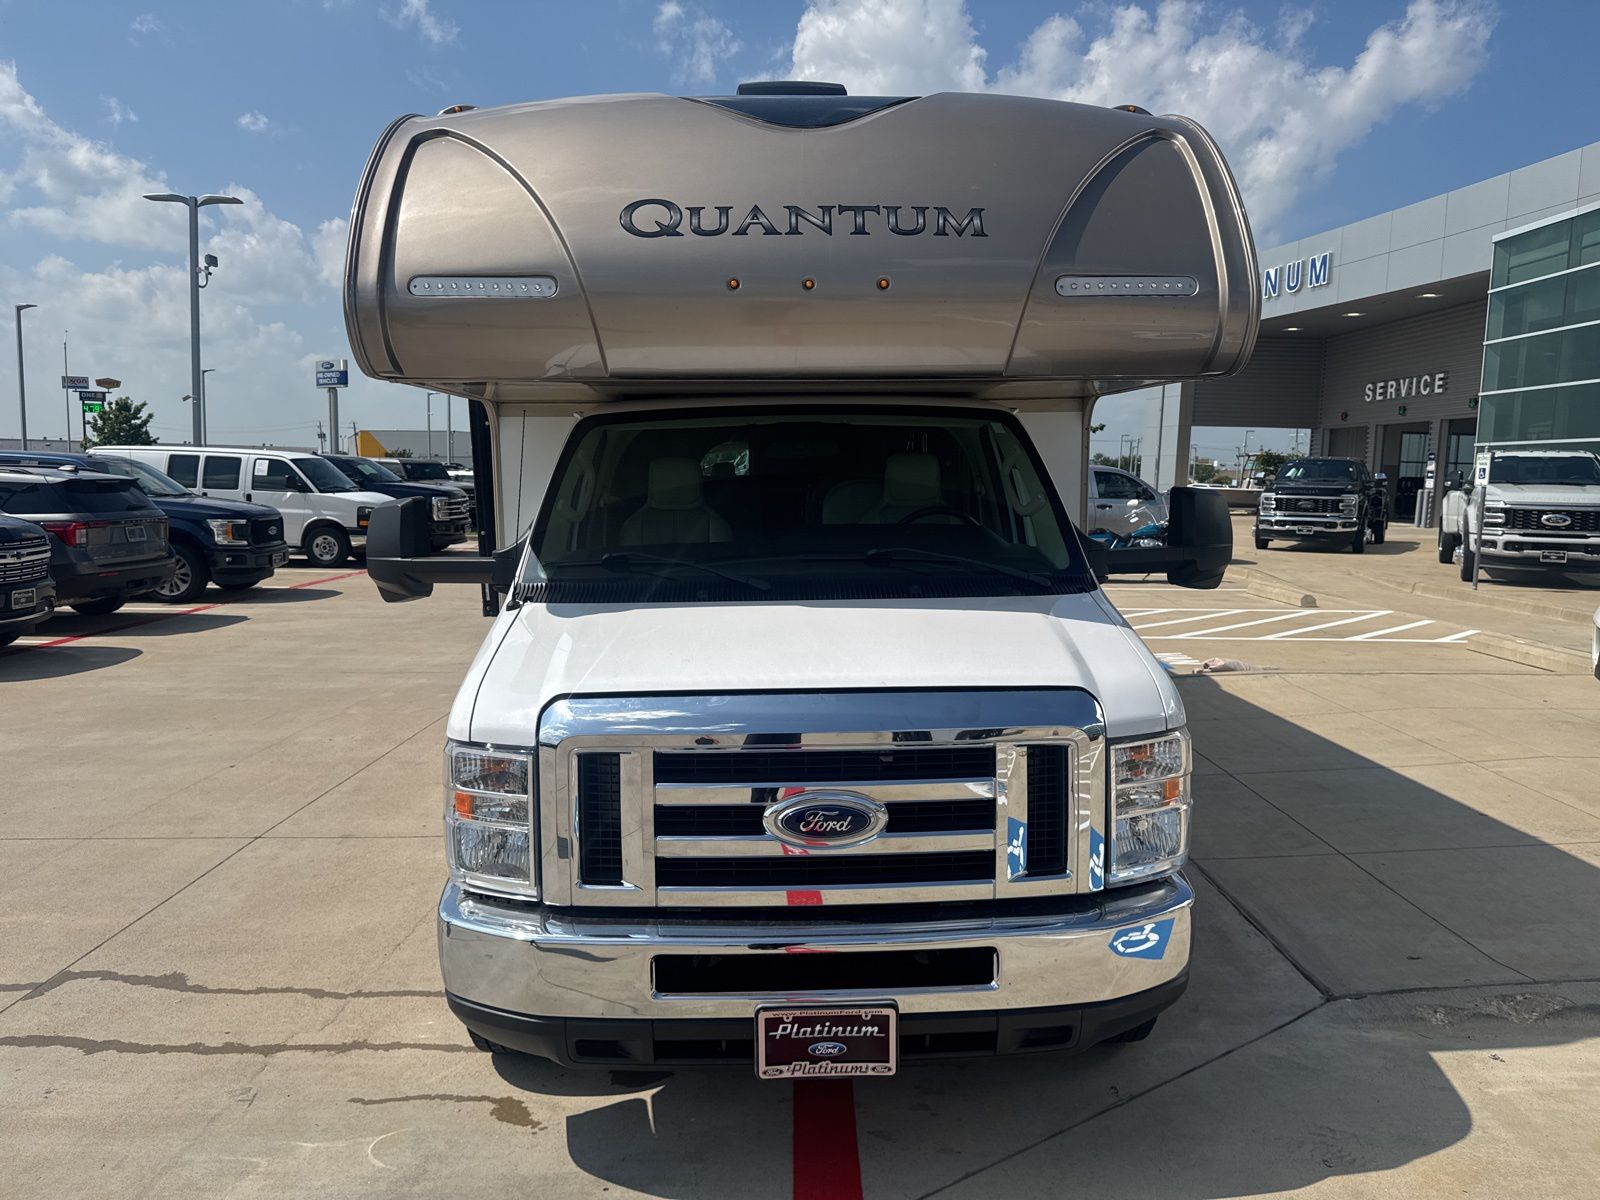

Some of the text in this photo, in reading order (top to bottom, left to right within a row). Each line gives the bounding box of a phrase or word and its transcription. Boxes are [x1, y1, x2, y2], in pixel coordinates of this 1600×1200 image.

[619, 198, 989, 238] QUANTUM
[1263, 252, 1330, 299] NUM
[1364, 372, 1445, 402] SERVICE
[799, 810, 853, 832] Ford
[768, 1021, 886, 1040] Platinum
[815, 1044, 840, 1055] Ford
[790, 1061, 864, 1076] Platinum
